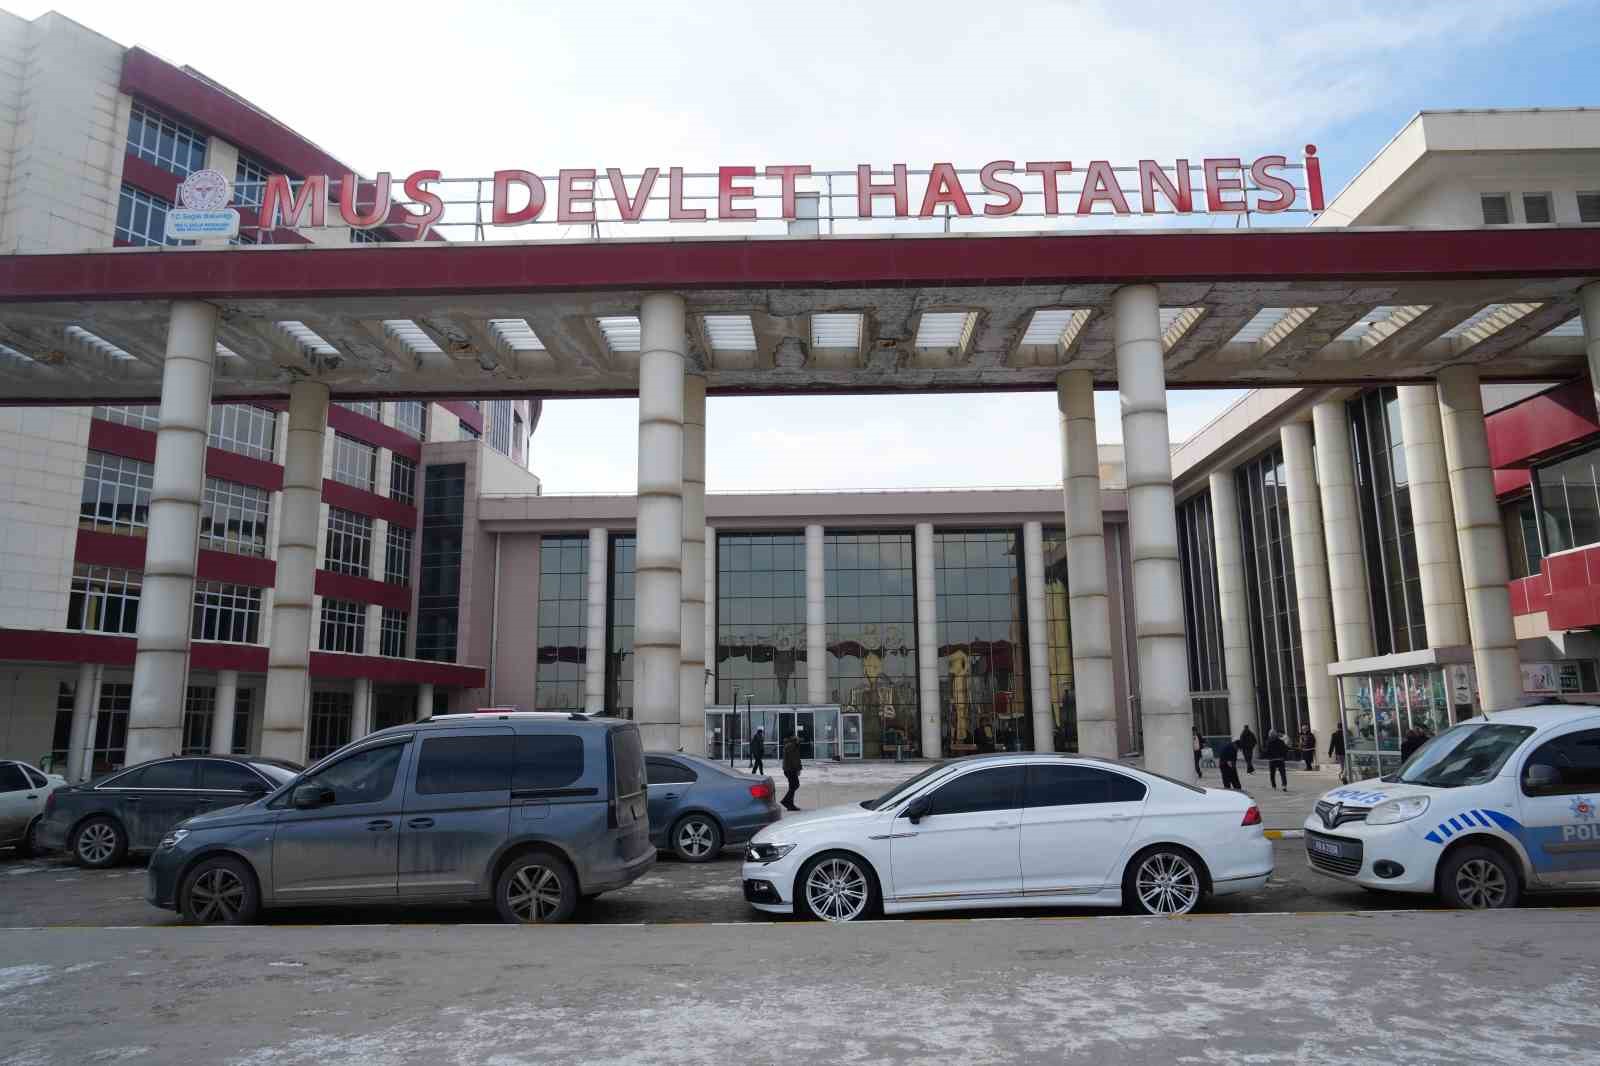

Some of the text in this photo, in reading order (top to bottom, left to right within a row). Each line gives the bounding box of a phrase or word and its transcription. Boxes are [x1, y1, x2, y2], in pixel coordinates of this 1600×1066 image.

[260, 144, 1325, 240] MUŞ DEVLET HASTANESİ
